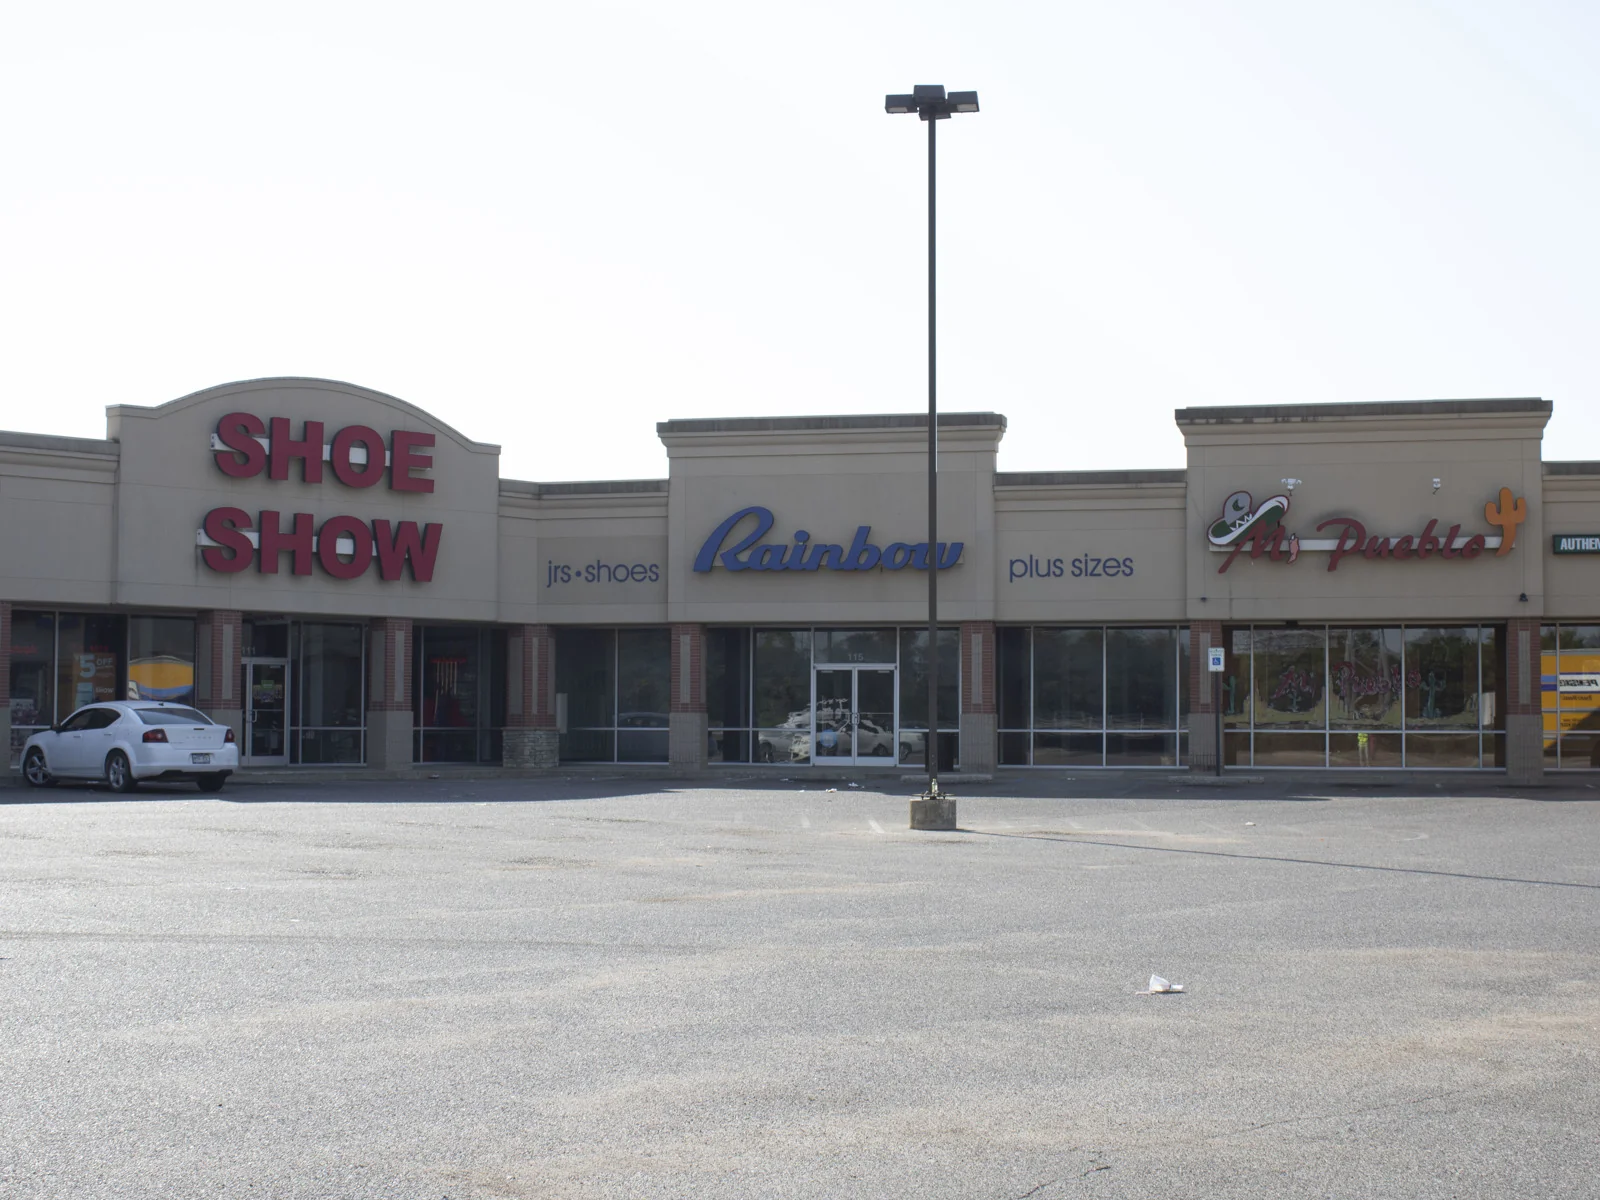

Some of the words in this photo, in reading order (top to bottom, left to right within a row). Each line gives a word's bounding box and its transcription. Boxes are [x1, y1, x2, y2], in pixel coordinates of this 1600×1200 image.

[213, 412, 436, 494] SHOE
[202, 506, 443, 582] SHOW
[693, 506, 964, 572] Rainbow
[1316, 517, 1486, 572] Pueblo
[1009, 554, 1064, 583] plus
[1071, 553, 1134, 577] sizes
[79, 654, 95, 678] 5
[848, 653, 864, 661] 115
